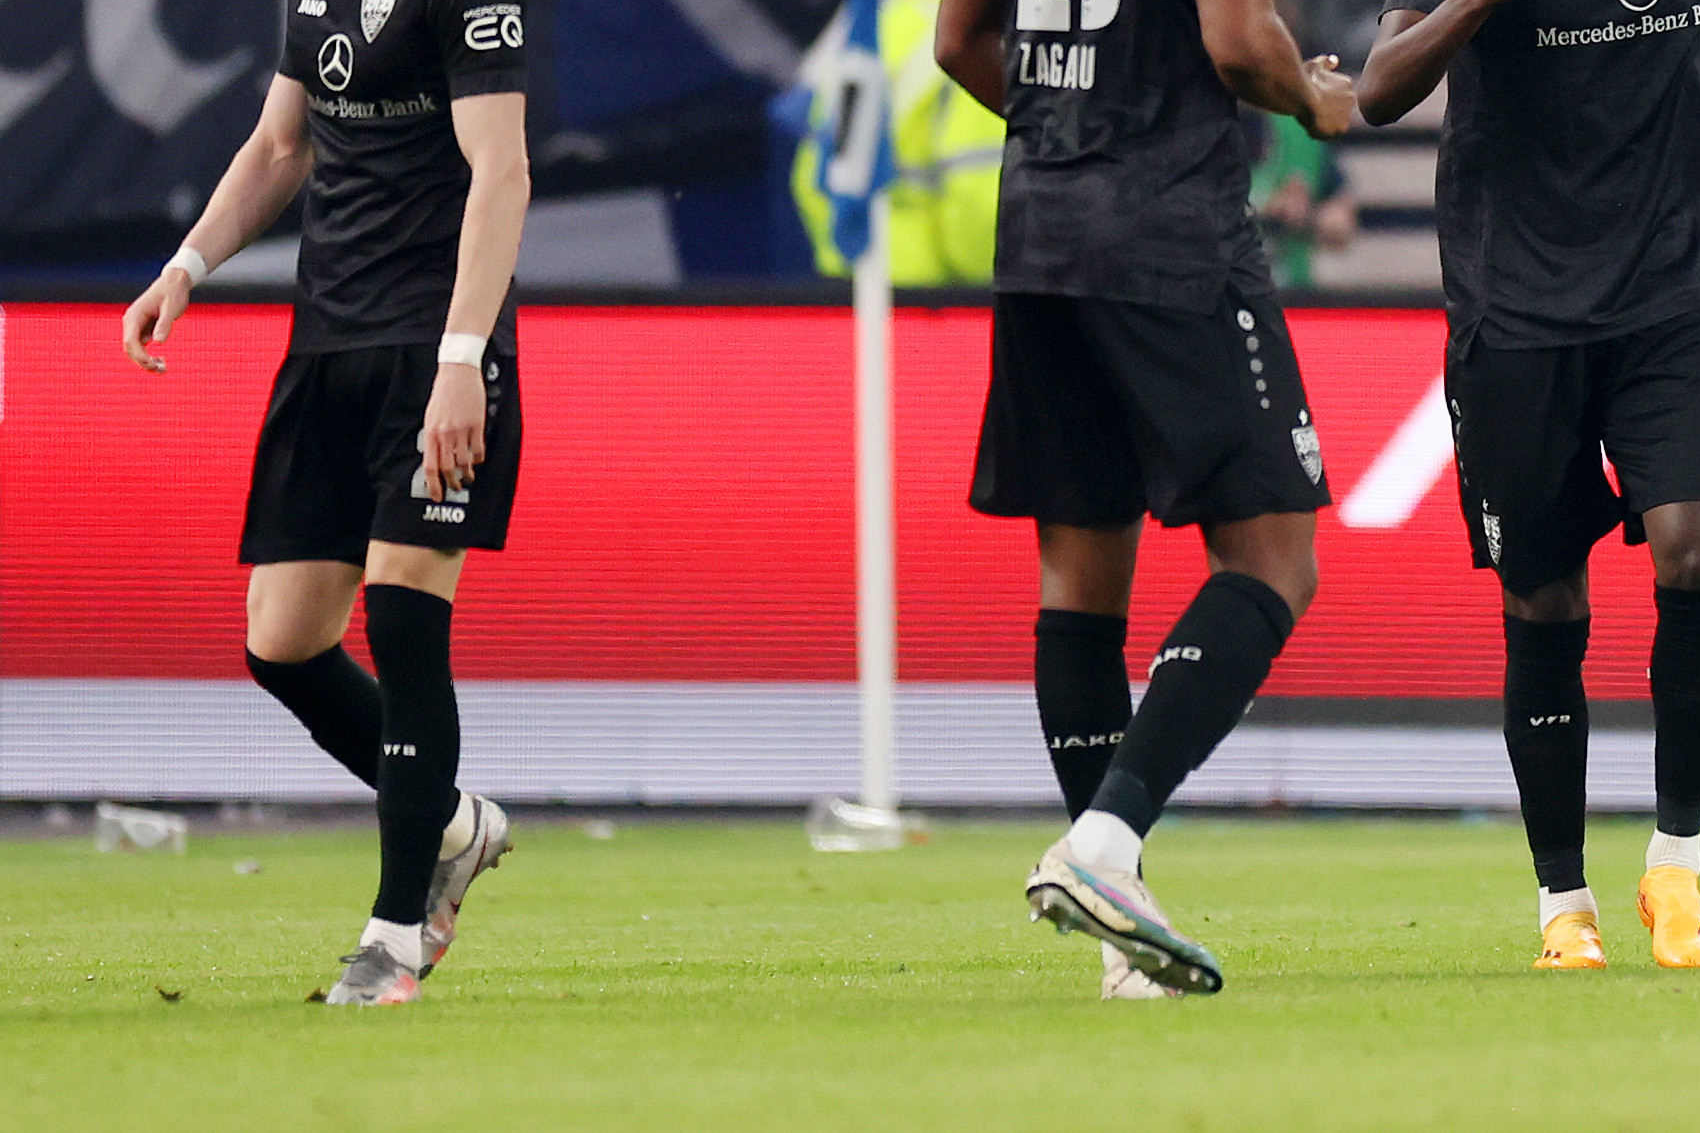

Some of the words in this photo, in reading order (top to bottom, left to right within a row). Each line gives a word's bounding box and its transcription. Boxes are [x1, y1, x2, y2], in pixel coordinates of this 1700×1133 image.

[464, 14, 523, 50] EQ
[1536, 10, 1689, 48] Mercedes-Benz
[422, 505, 465, 523] JAKO
[1050, 731, 1125, 749] JAKO
